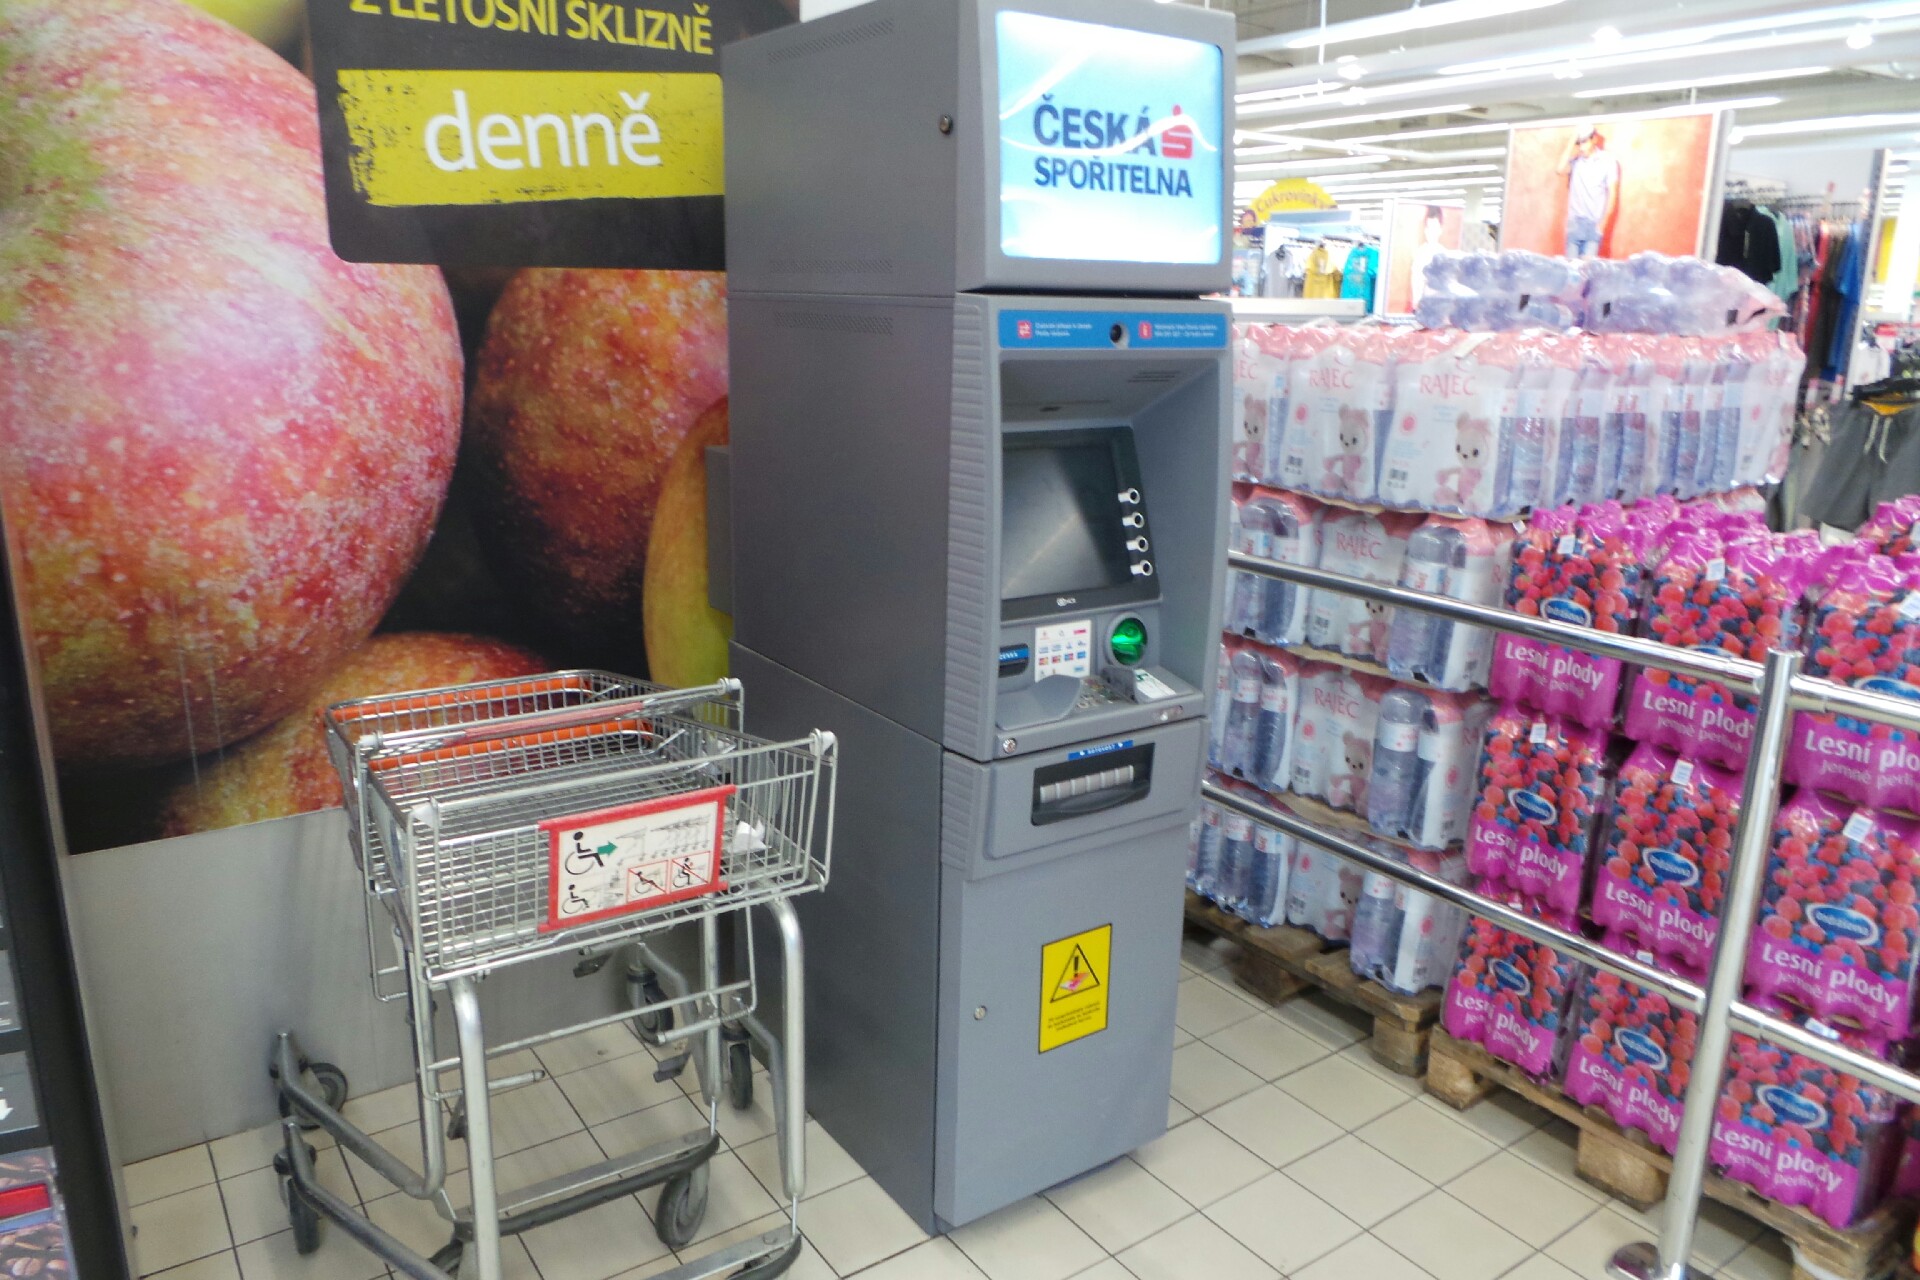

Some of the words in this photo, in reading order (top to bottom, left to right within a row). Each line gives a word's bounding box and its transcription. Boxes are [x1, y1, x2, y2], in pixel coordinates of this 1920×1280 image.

[566, 0, 714, 55] SKLIZNĚ
[424, 89, 661, 172] denně
[1033, 94, 1157, 157] ČESKÁ
[1033, 156, 1193, 198] SPOŘITELNA
[1308, 368, 1354, 390] RAJEC
[1418, 373, 1478, 399] RAJEC
[1335, 530, 1383, 561] RAJEC
[1552, 655, 1605, 692] plody
[1314, 687, 1361, 720] RAJEC
[1643, 689, 1698, 720] Lesní
[1702, 707, 1755, 739] plod
[1805, 729, 1875, 765] Lesní
[1879, 744, 1920, 774] plo
[1520, 844, 1569, 882] plody
[1605, 879, 1655, 919] Lesní
[1659, 907, 1716, 949] plody
[1763, 942, 1825, 979] Lesní
[1829, 967, 1900, 1014] plody
[1496, 1012, 1540, 1055] plody
[1629, 1086, 1680, 1133] plody
[1713, 1121, 1775, 1160] Lesní
[1777, 1150, 1844, 1193] plody
